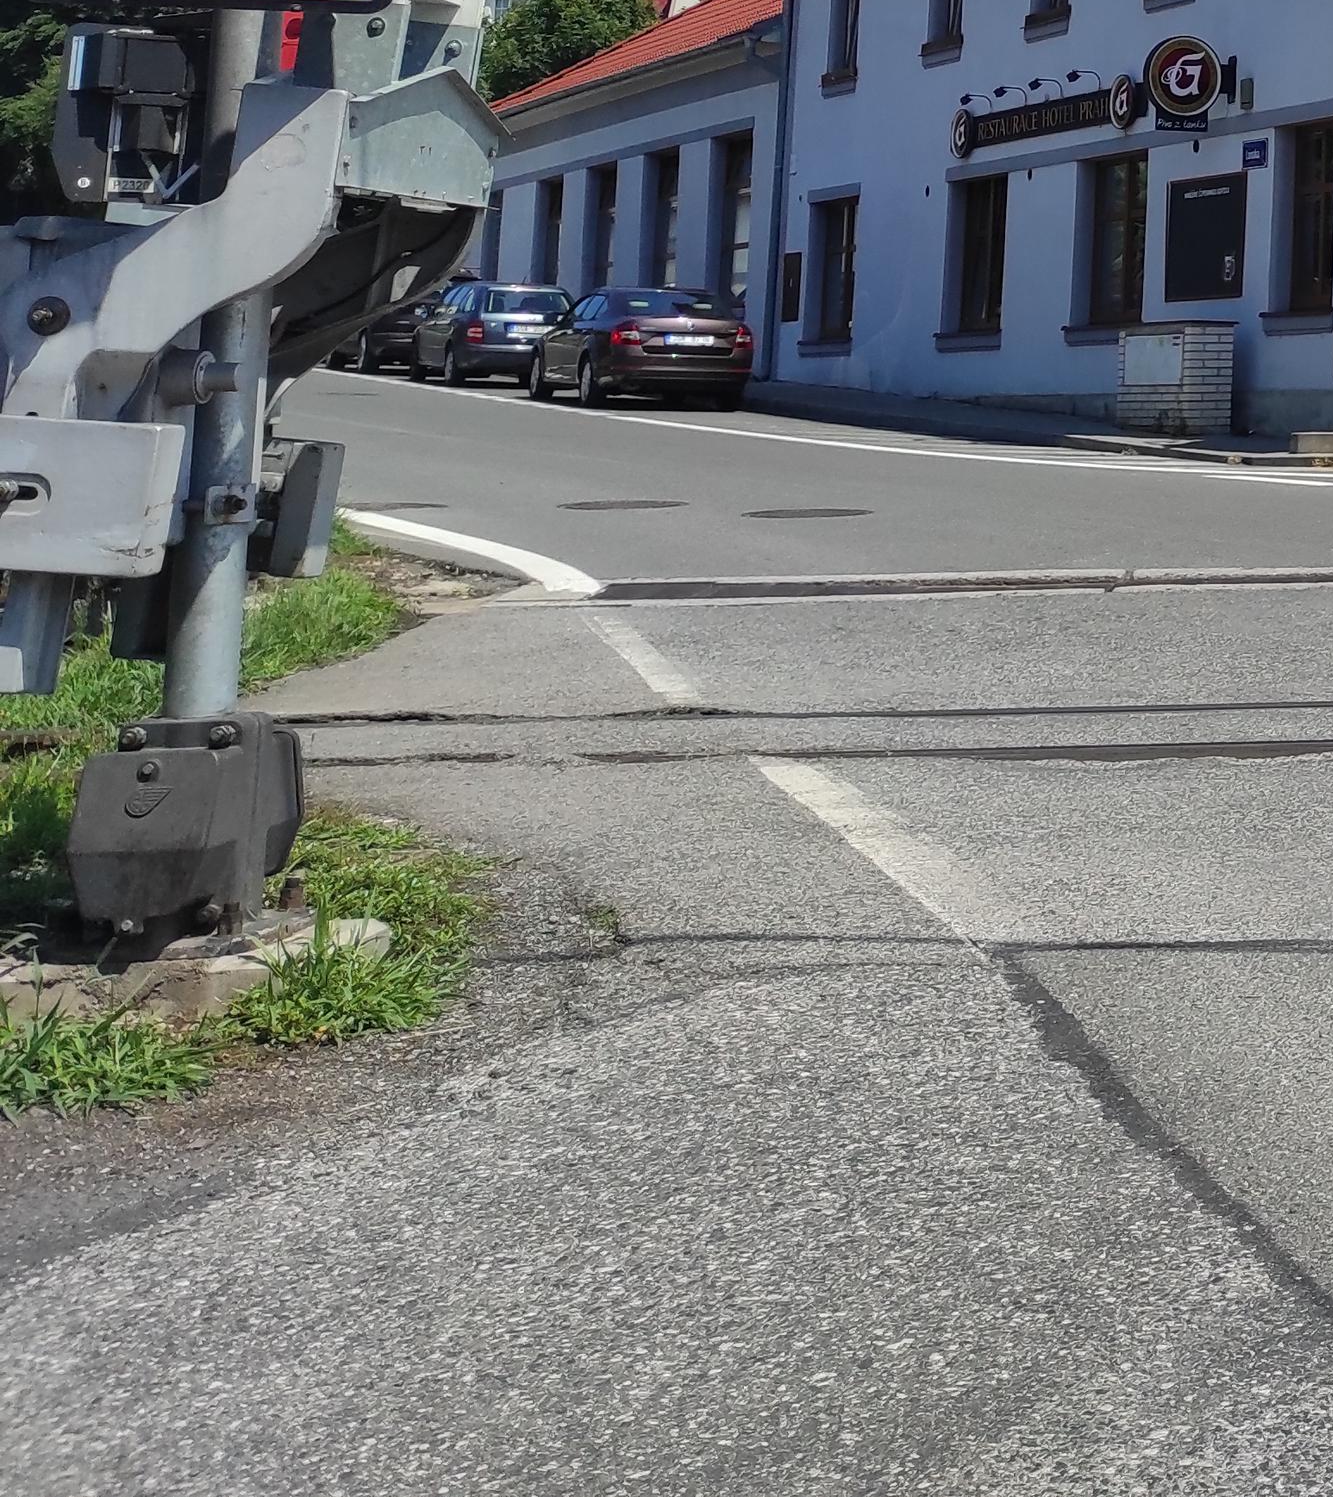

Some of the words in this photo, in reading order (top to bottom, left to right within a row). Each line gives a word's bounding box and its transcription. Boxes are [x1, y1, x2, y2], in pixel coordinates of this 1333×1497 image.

[978, 111, 1038, 141] RESTAURACE
[1042, 104, 1075, 127] HOTEL
[1079, 97, 1109, 121] PRAH
